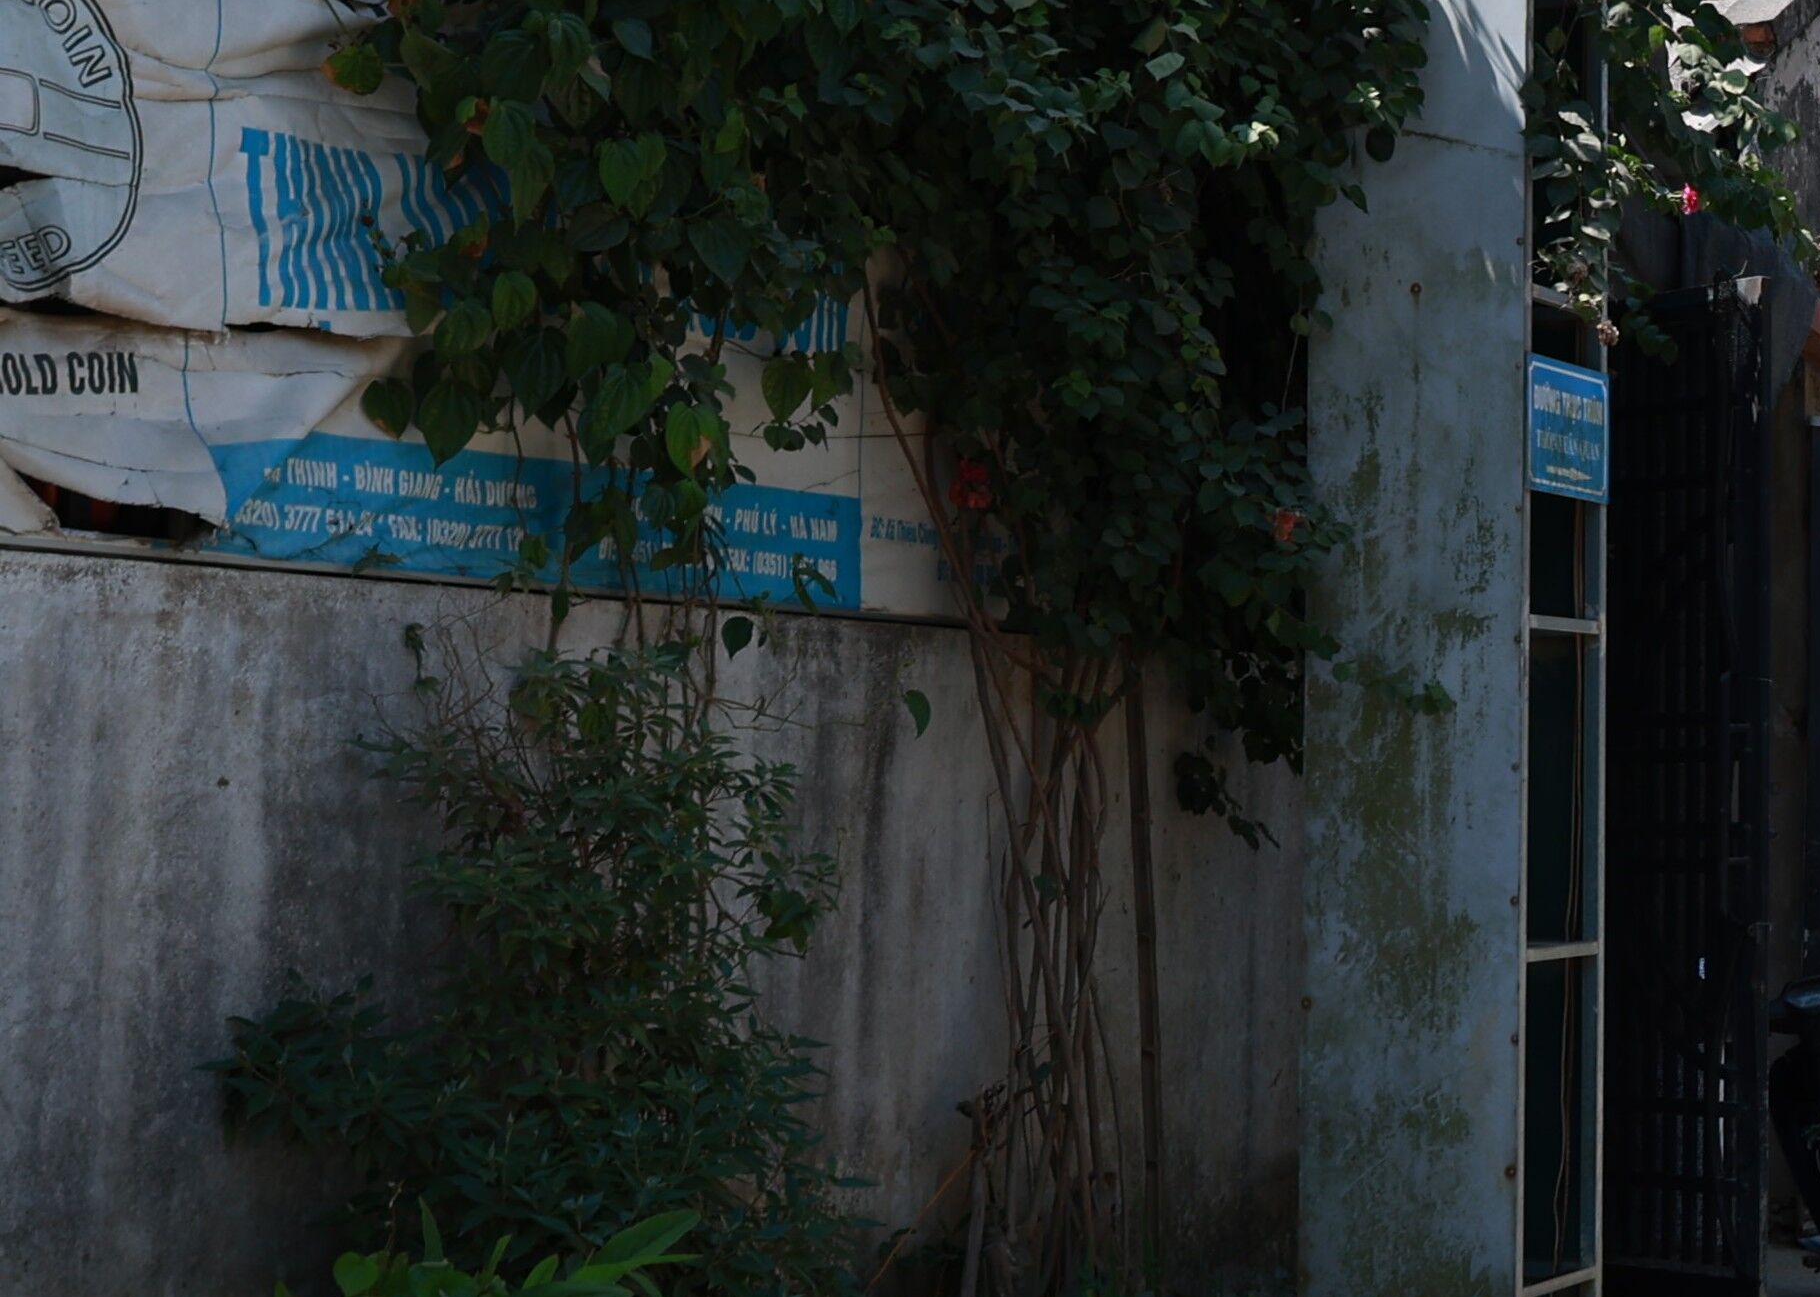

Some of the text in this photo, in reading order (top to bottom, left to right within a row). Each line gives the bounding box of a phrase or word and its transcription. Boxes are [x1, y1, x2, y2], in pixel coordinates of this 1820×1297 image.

[0, 351, 139, 395] OLD COIN
[287, 457, 337, 492] THỊNH
[354, 459, 395, 494] BÌNH
[398, 470, 443, 500] GIANG
